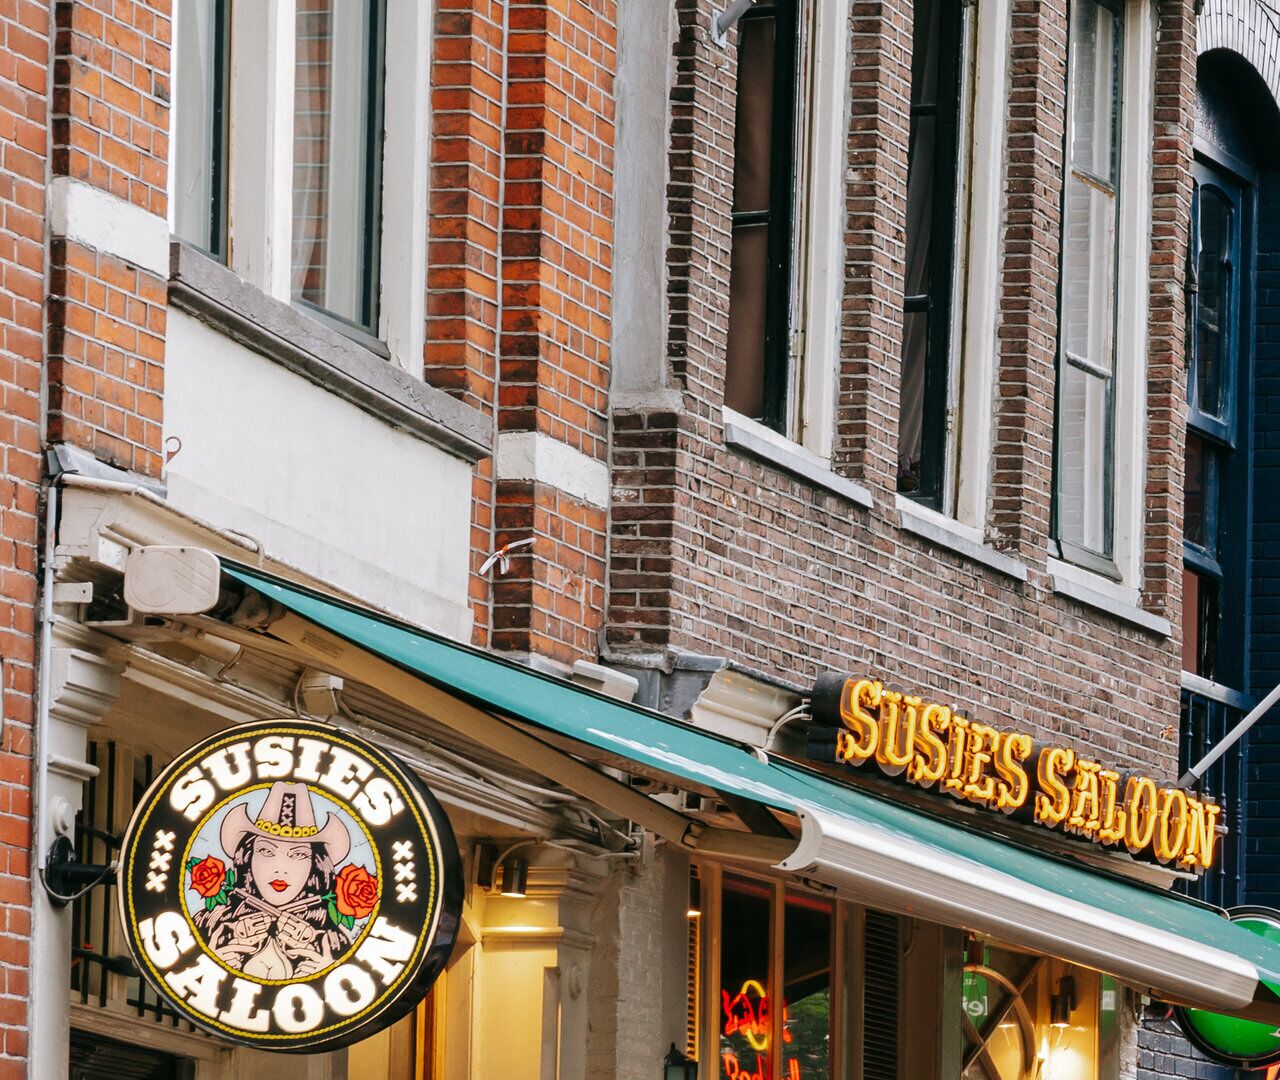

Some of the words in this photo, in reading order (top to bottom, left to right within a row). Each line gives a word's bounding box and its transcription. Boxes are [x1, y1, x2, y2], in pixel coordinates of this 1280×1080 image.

[169, 735, 405, 827] SUSIES
[836, 678, 1033, 812] SUSIES
[1035, 746, 1221, 868] SALOON
[138, 911, 418, 1034] SALOON
